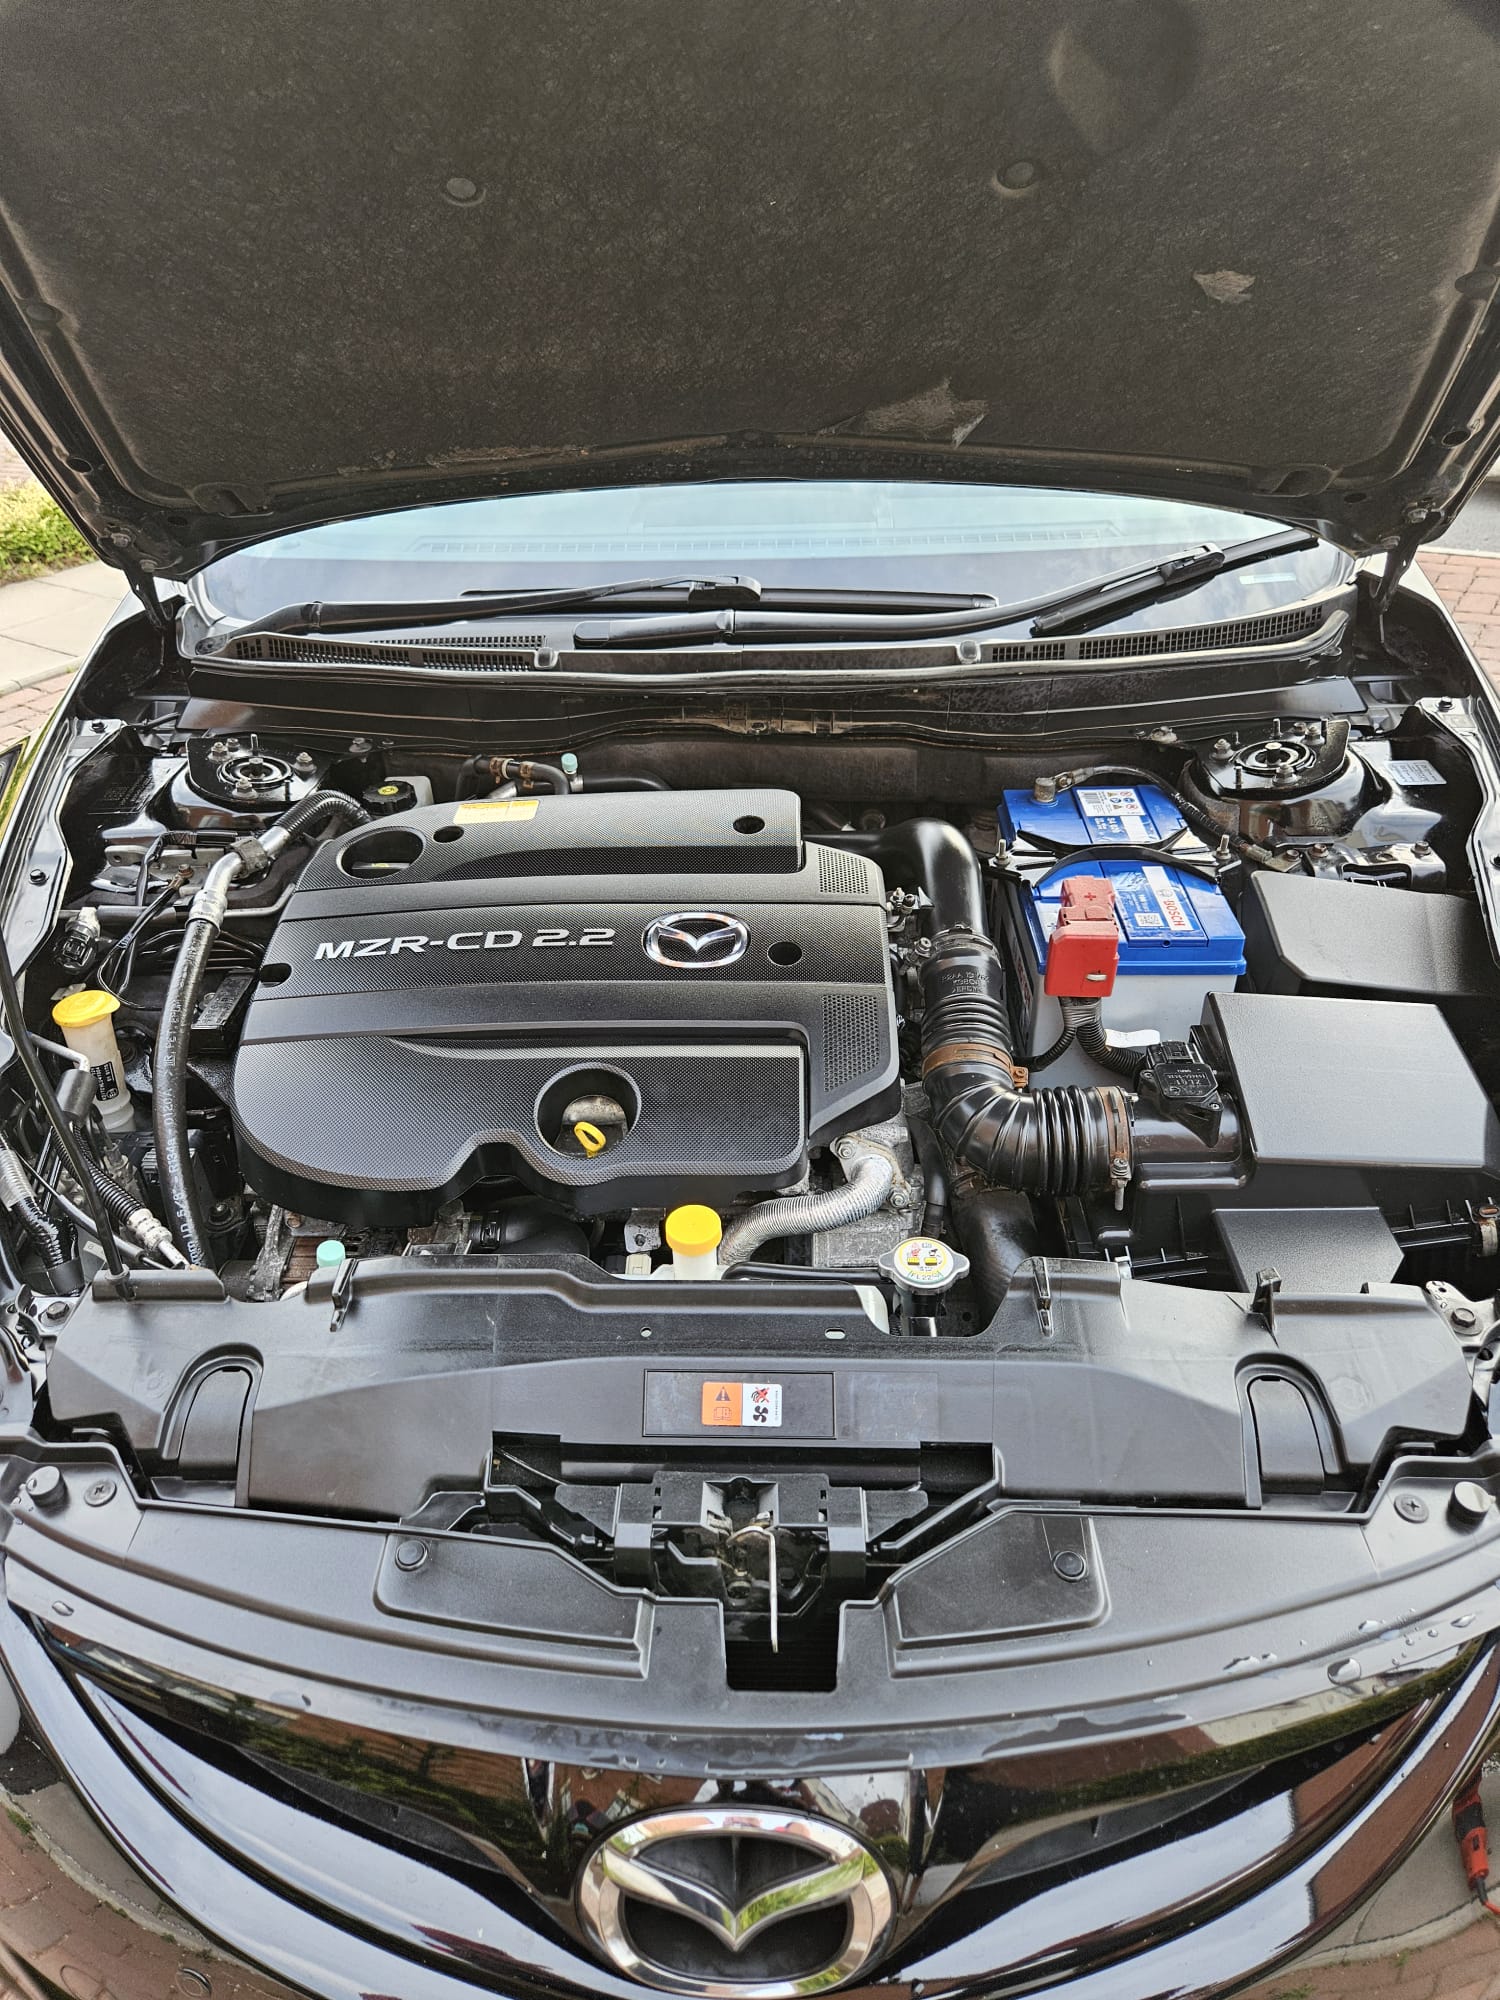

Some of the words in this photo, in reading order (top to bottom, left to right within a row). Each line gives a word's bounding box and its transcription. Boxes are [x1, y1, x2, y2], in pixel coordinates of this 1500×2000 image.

[1163, 900, 1185, 927] BOSCH
[314, 929, 523, 961] MZR-CD
[532, 928, 616, 947] 2.2
